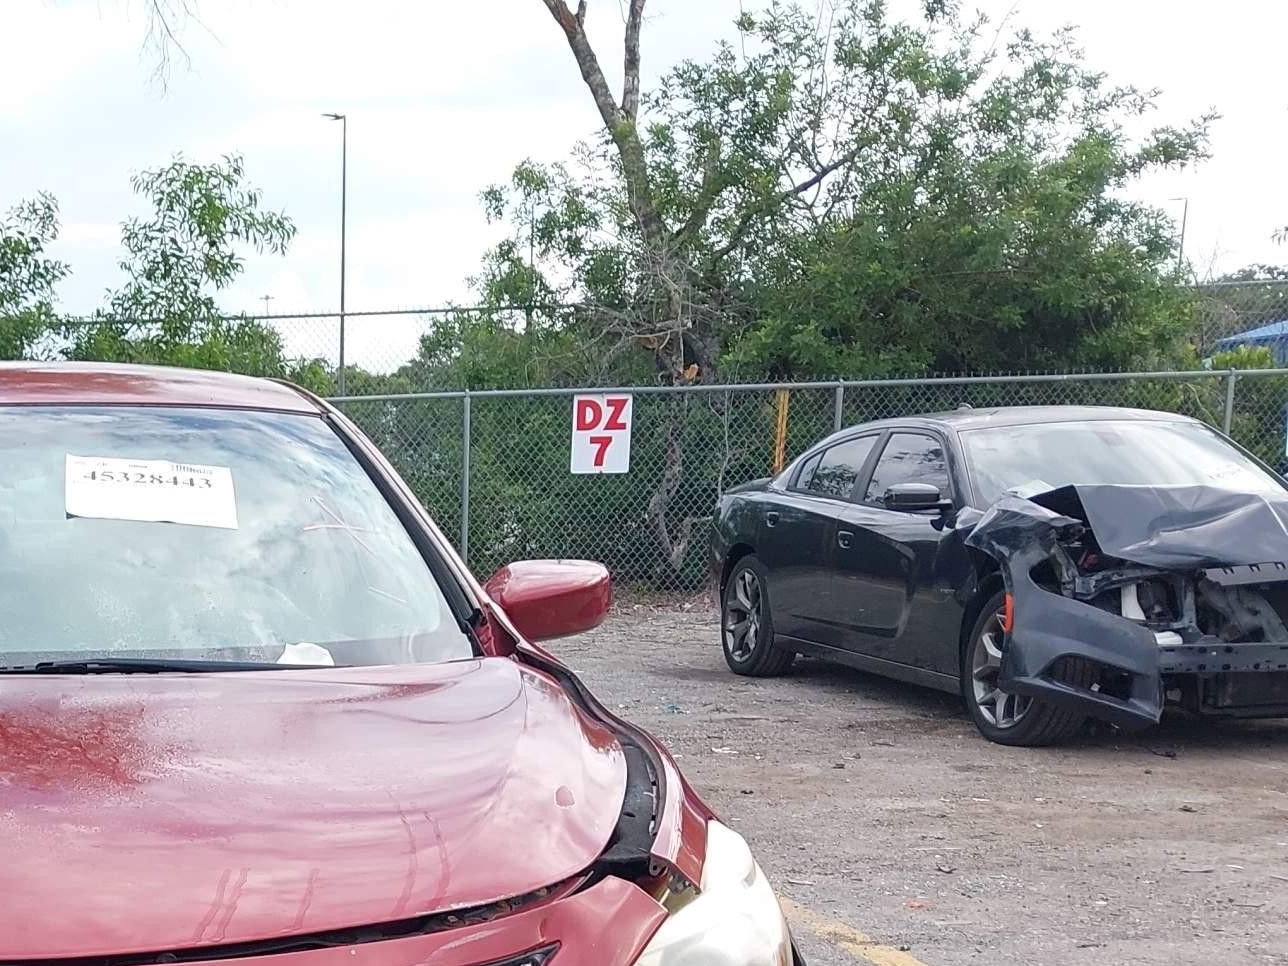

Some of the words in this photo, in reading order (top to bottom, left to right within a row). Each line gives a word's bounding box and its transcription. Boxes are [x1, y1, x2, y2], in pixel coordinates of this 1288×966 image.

[576, 399, 629, 431] DZ
[589, 436, 613, 466] 7
[83, 470, 212, 489] 45328443
